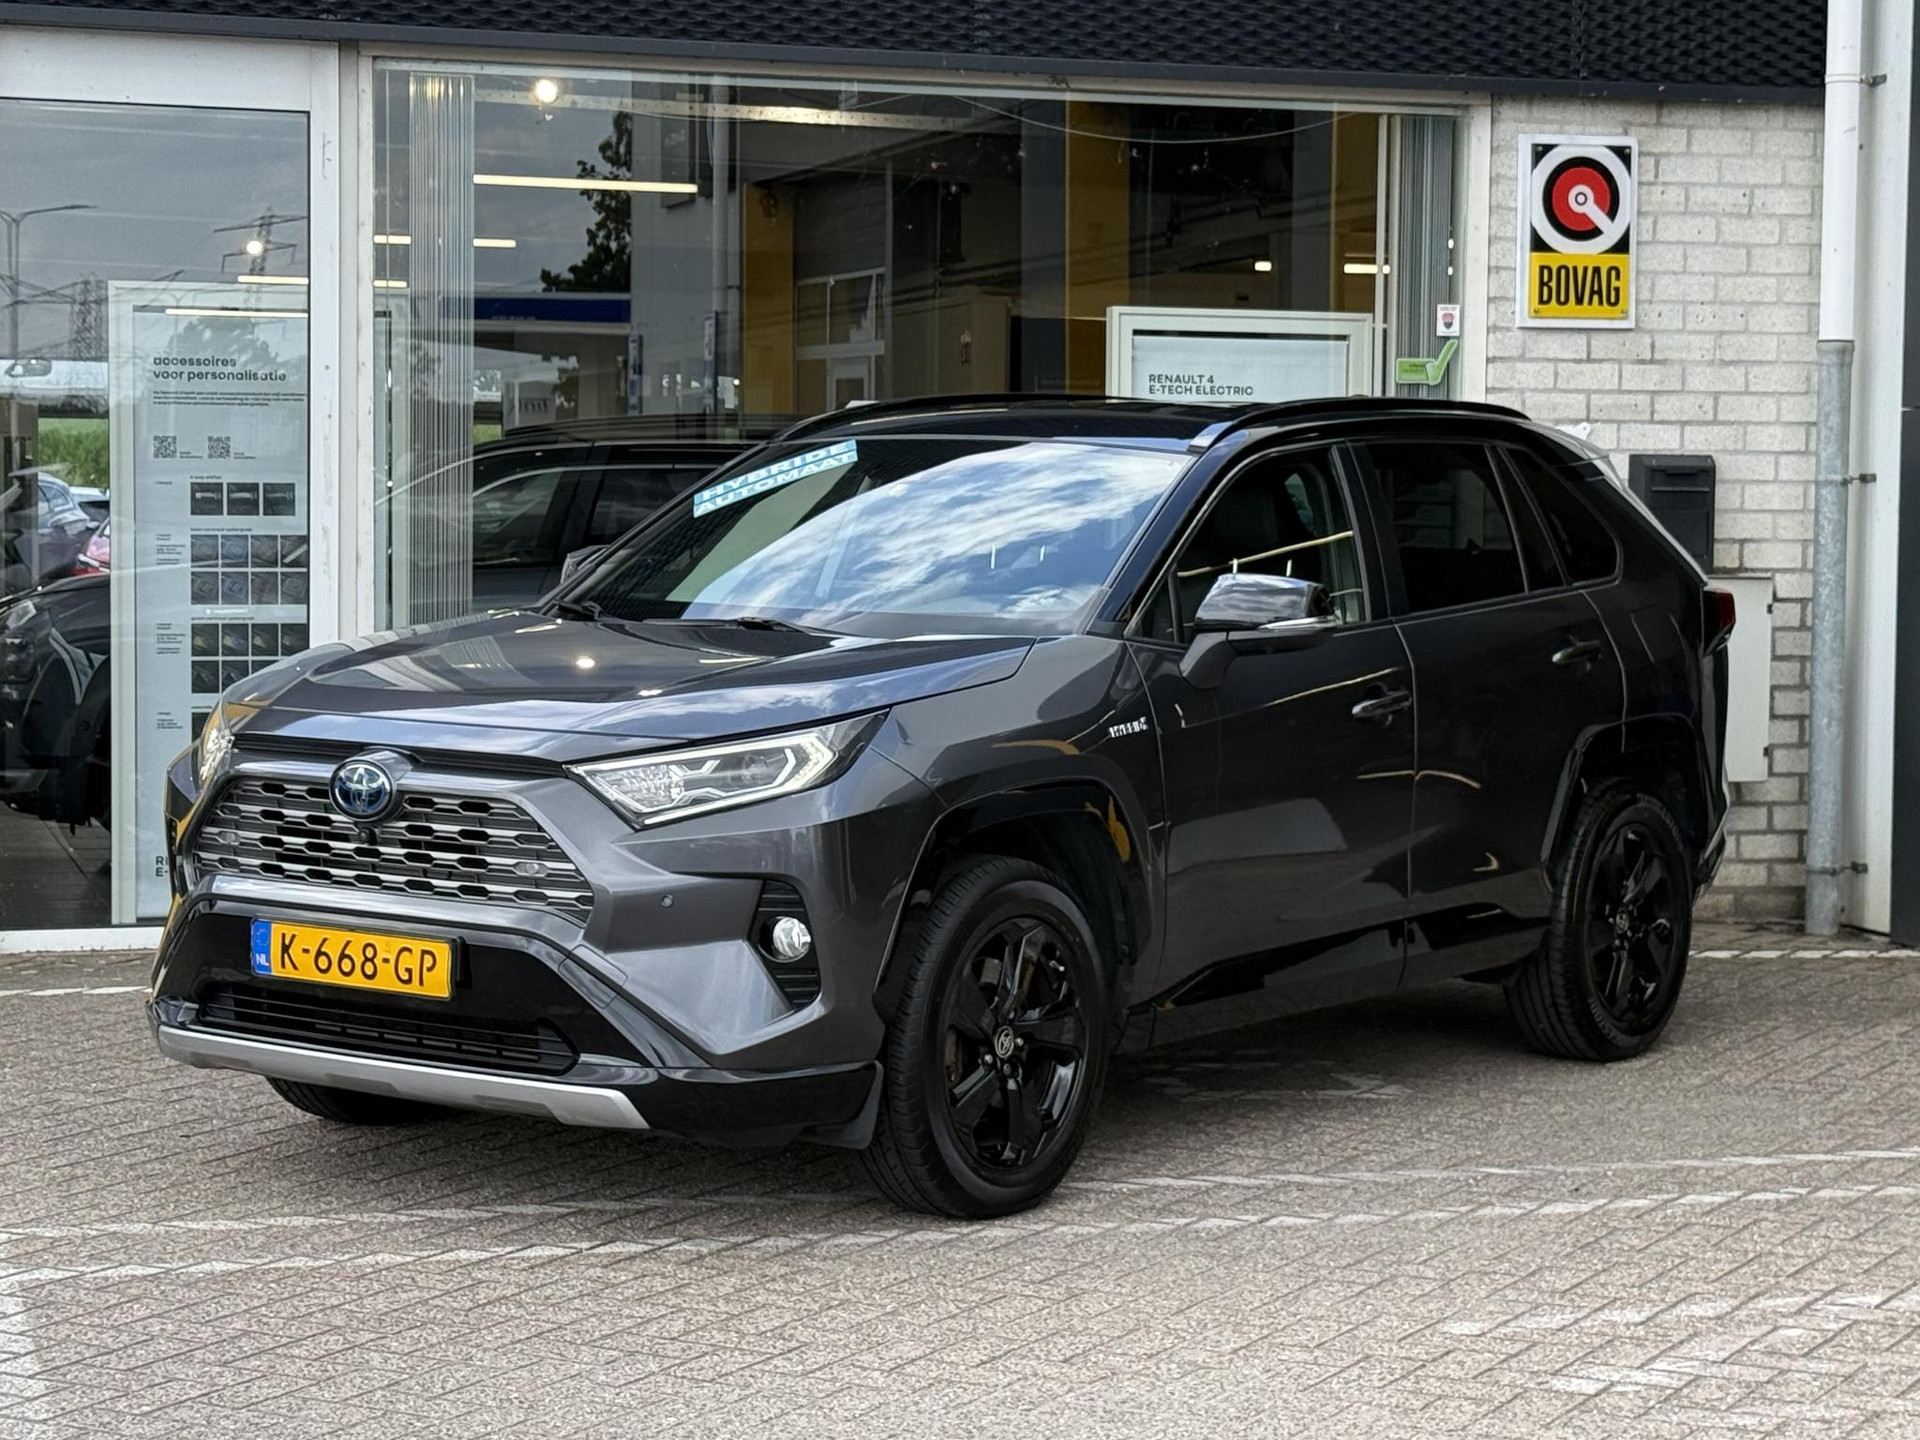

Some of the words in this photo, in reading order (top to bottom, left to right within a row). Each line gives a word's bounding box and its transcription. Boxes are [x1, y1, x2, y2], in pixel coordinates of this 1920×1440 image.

[1538, 264, 1621, 307] BOVAG
[153, 356, 237, 367] accessoires
[153, 370, 184, 380] voor
[187, 369, 287, 383] personalisatie
[1148, 374, 1205, 384] RENAULT
[1207, 375, 1214, 384] 4
[1149, 385, 1193, 395] E-TECH
[1195, 385, 1254, 396] ELECTRIC
[702, 443, 848, 501] HYBRIDE
[694, 453, 853, 514] AUTOMAAT
[255, 953, 270, 966] NL
[279, 932, 438, 987] K-668-GP
